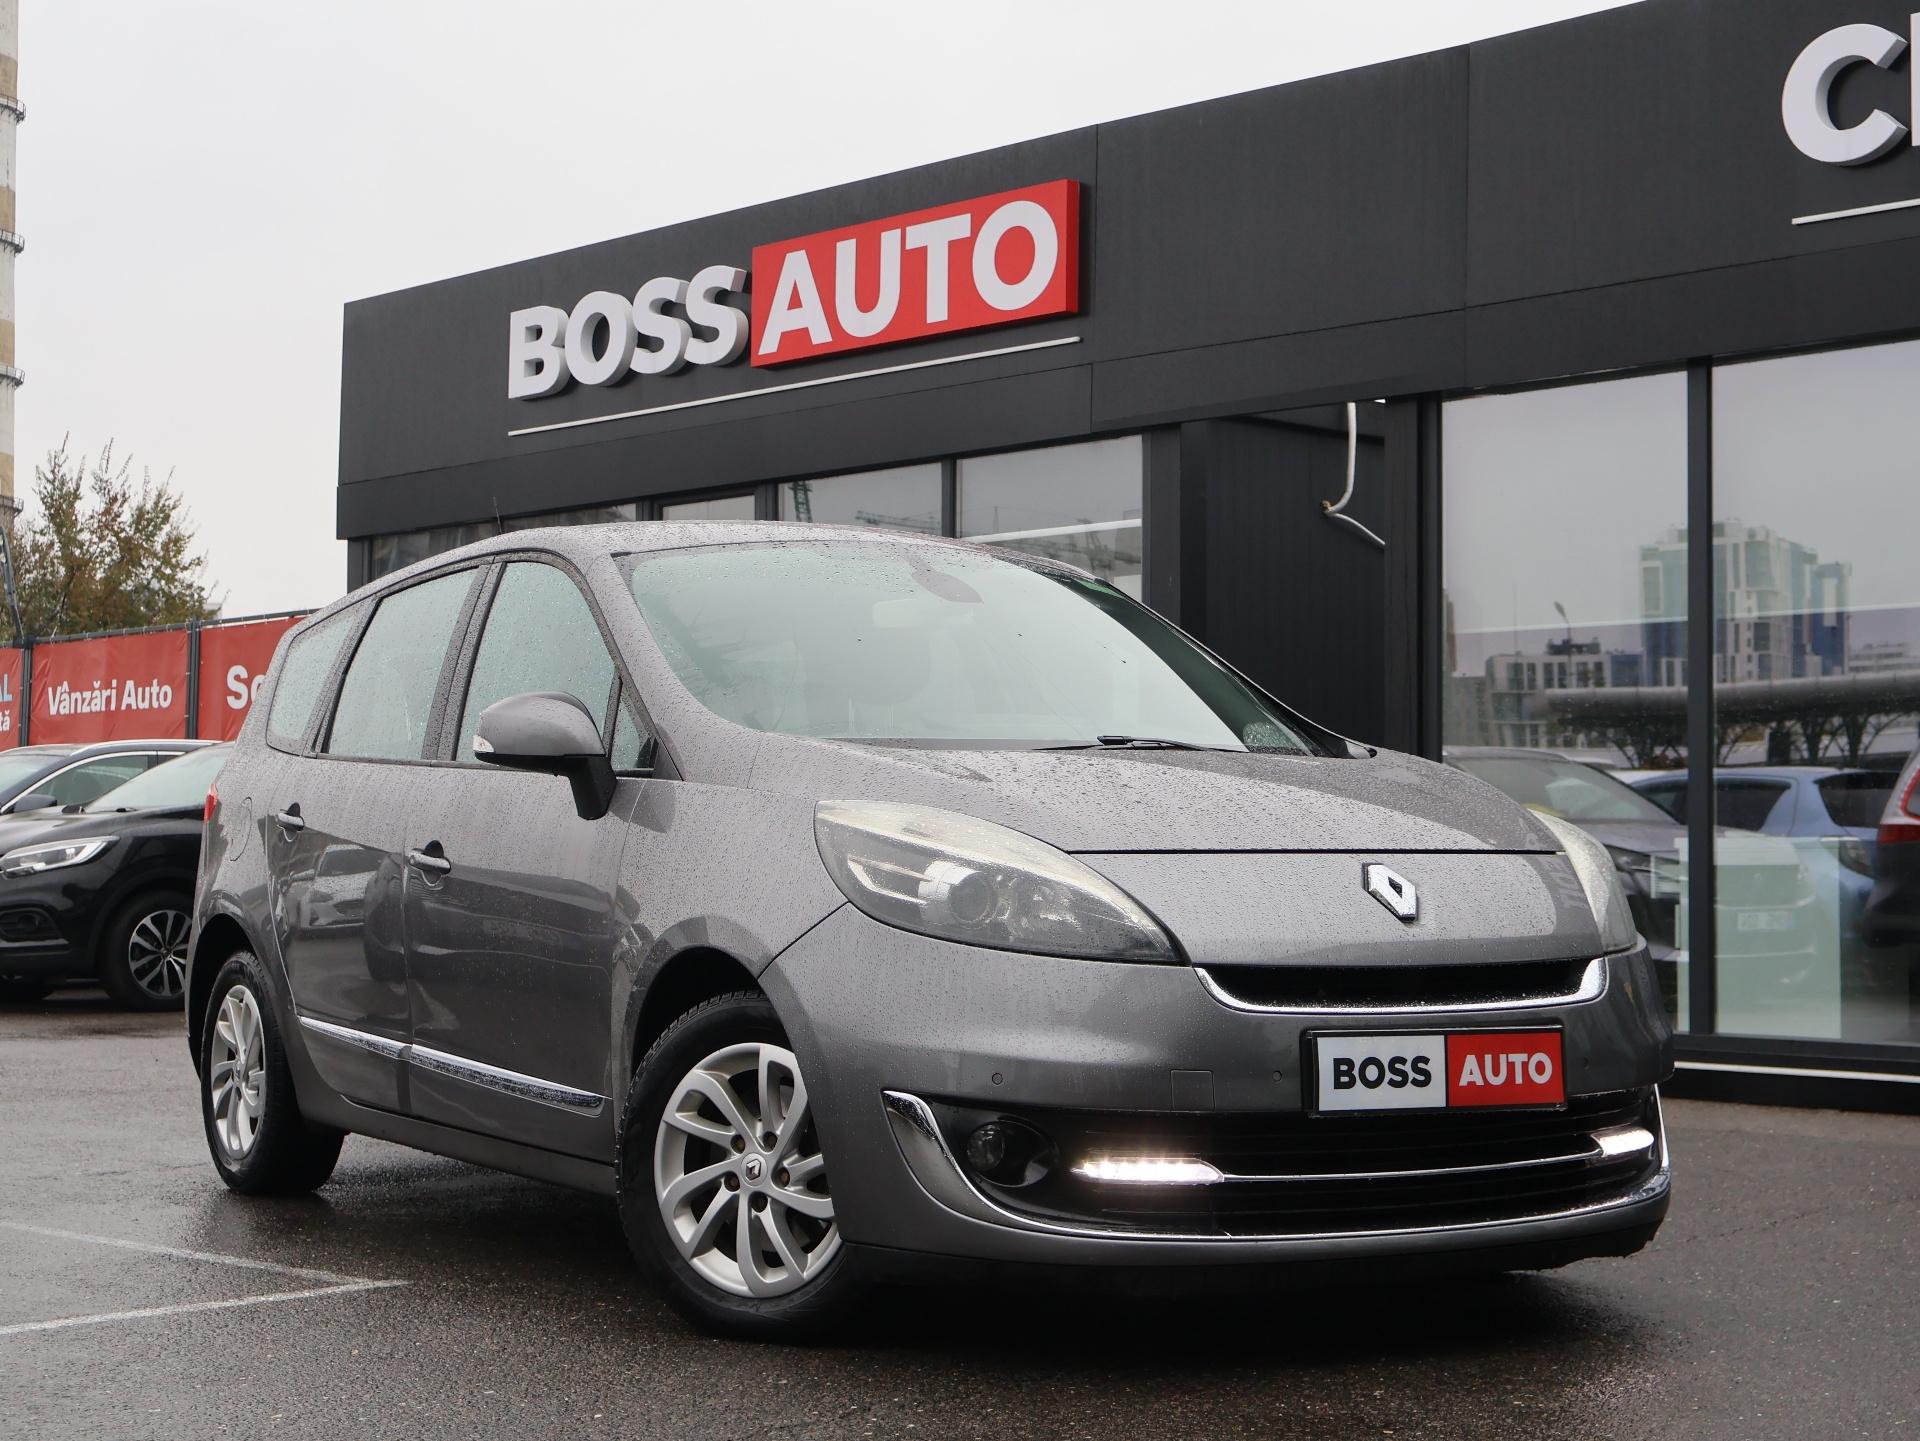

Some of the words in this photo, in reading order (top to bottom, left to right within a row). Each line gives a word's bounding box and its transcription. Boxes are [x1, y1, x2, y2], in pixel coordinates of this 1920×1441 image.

[1782, 12, 1920, 166] C
[508, 265, 749, 400] BOSS
[758, 199, 1059, 356] AUTO
[48, 679, 117, 715] Vânzări
[121, 678, 172, 711] Auto
[1333, 1055, 1432, 1090] BOSS
[1459, 1052, 1553, 1087] AUTO
